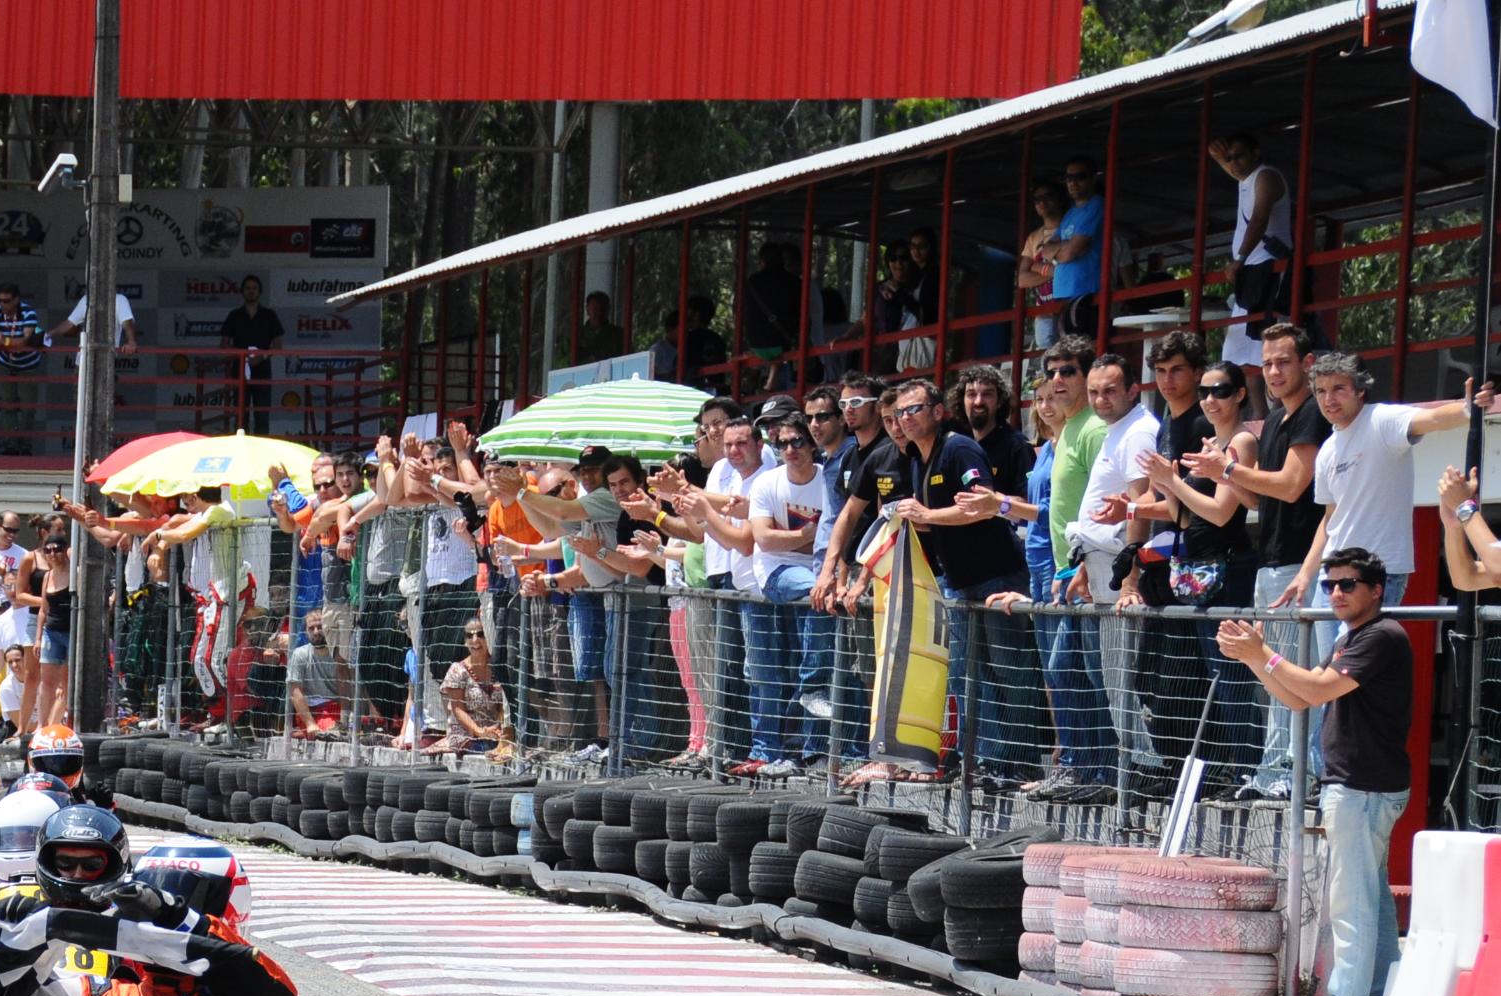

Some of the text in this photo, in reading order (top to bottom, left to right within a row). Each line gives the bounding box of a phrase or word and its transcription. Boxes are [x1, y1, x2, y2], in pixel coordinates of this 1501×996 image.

[129, 202, 192, 257] KARTING
[186, 281, 239, 294] HELIX
[297, 318, 352, 331] HELIX
[67, 829, 96, 838] HJC
[144, 858, 201, 872] TEXACO
